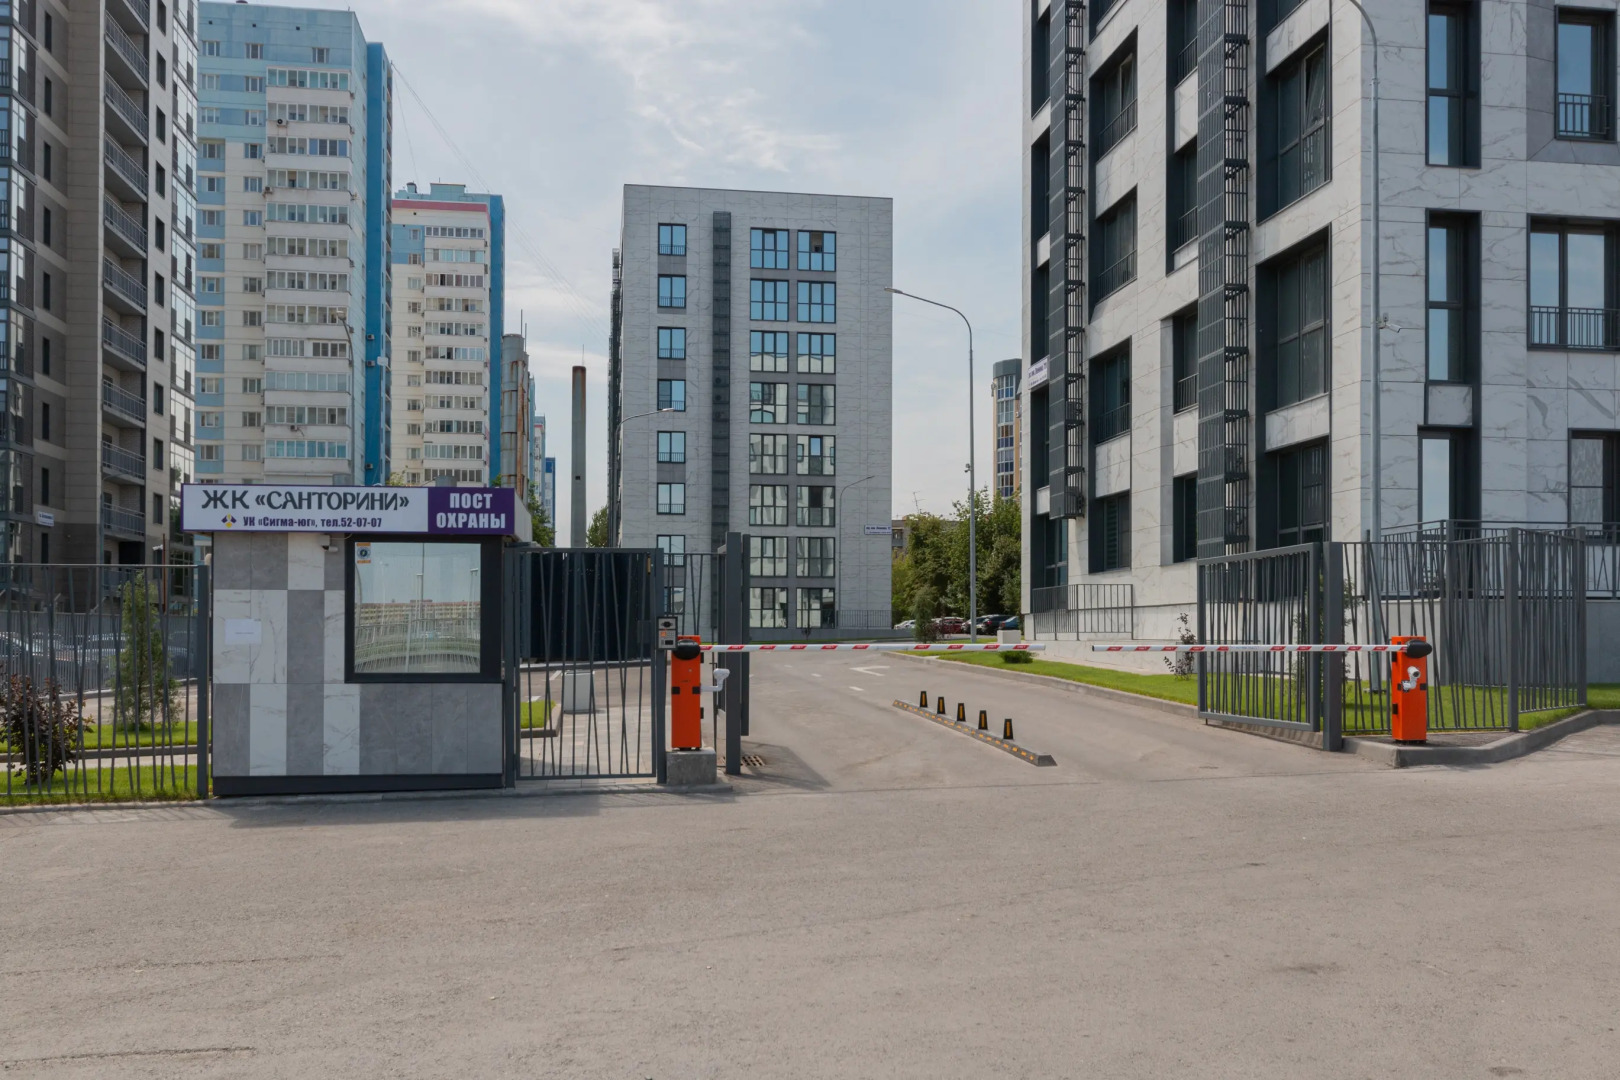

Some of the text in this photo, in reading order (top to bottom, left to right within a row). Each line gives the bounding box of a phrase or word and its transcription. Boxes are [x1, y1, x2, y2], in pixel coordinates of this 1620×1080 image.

[201, 489, 410, 511] ЖК «САНТОРИНИ»
[449, 492, 493, 509] ПОСТ
[243, 516, 256, 527] УК
[436, 512, 506, 529] ОХРАНЫ
